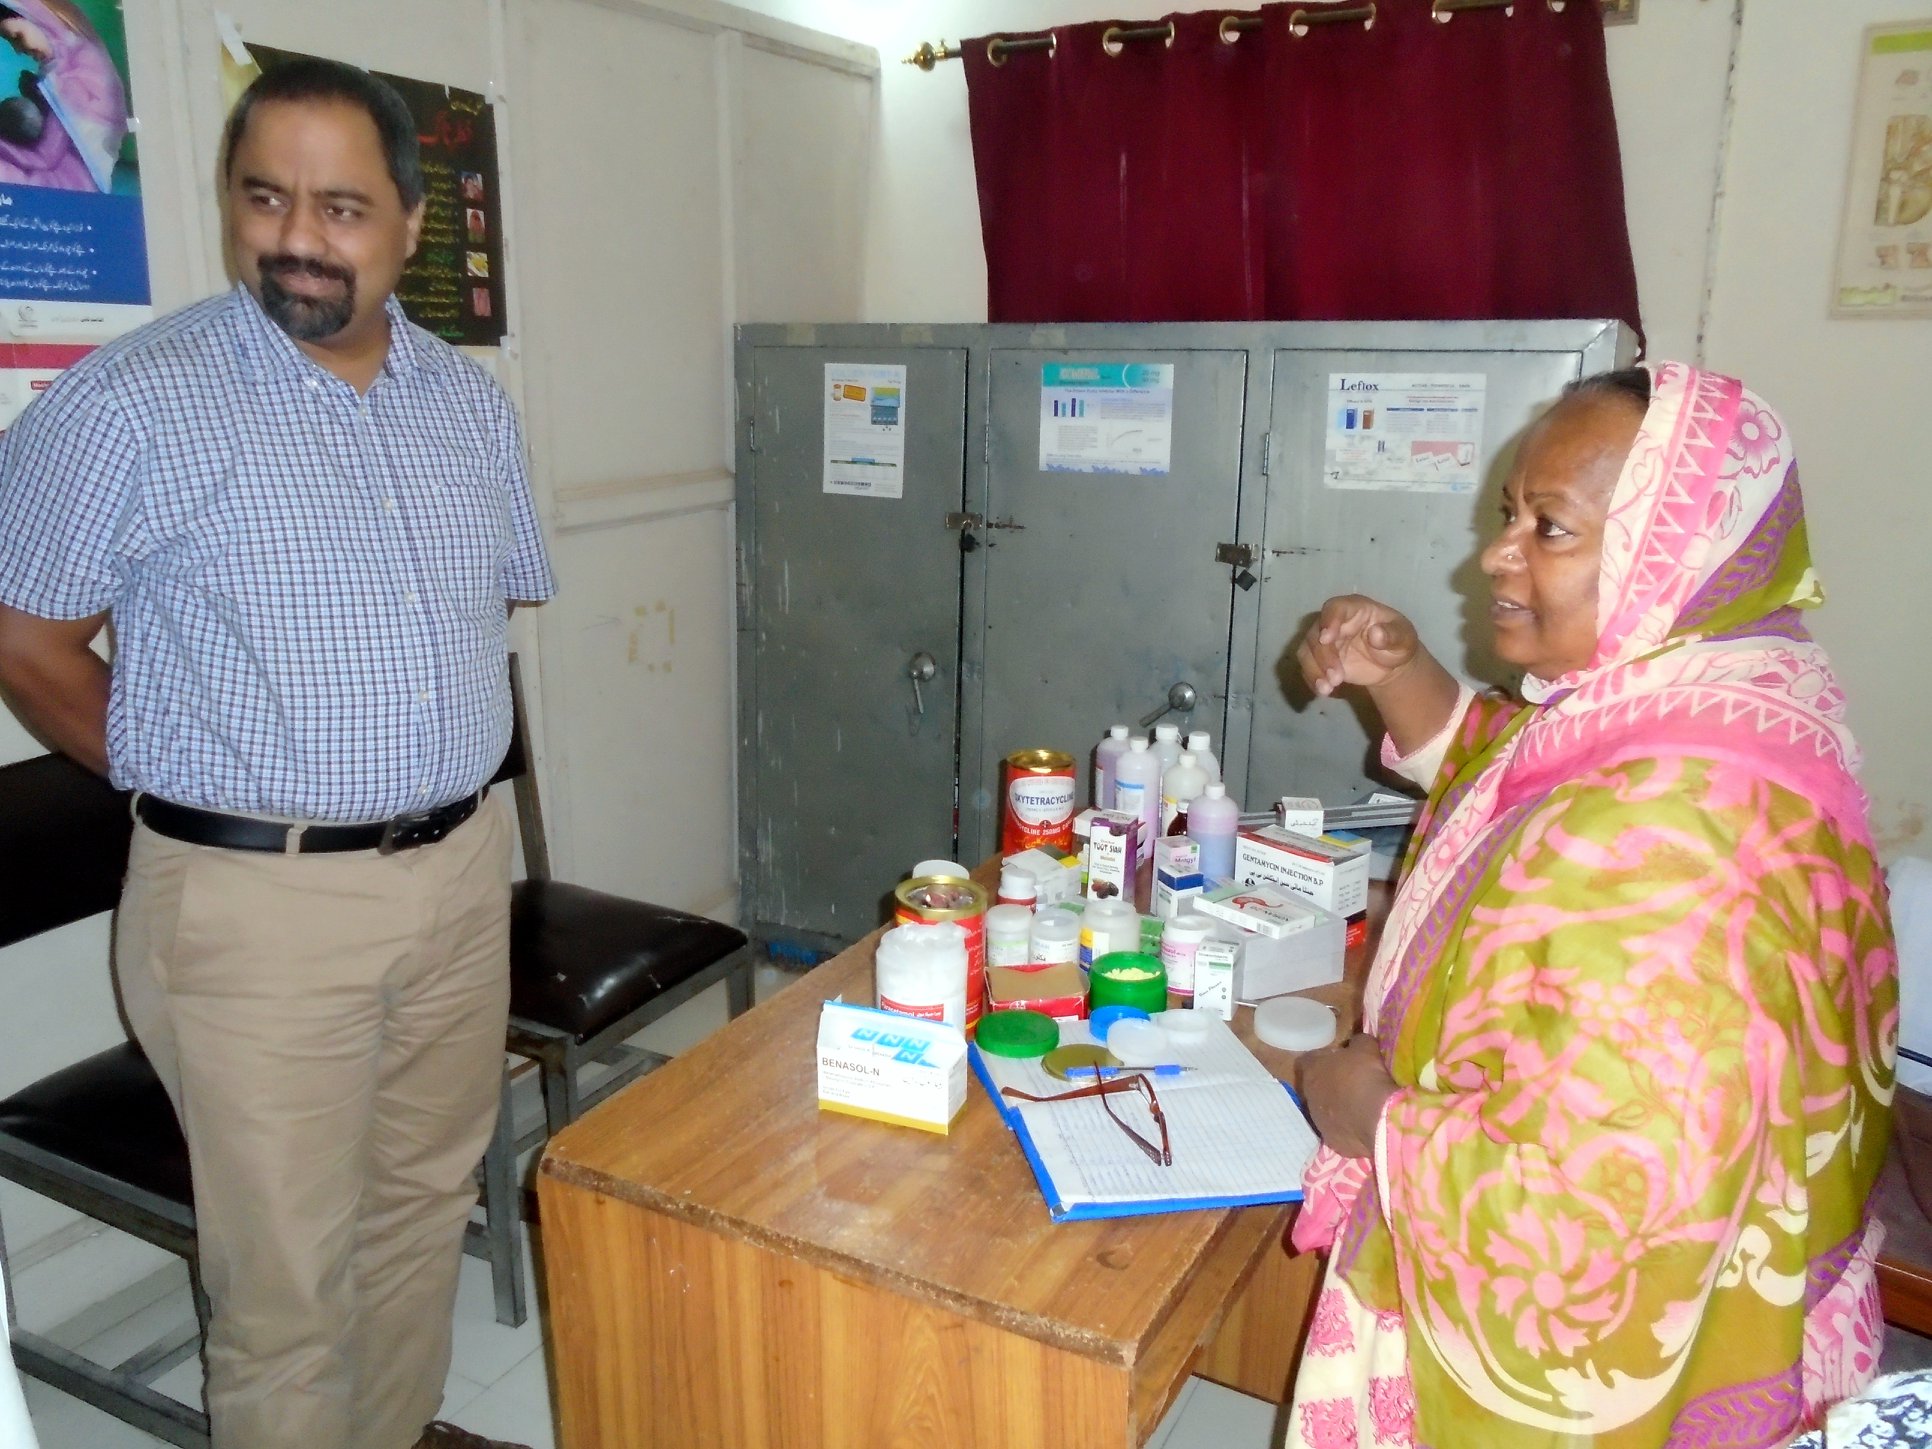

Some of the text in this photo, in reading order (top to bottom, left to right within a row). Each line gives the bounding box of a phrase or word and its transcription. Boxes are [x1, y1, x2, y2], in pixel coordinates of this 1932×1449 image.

[1093, 841, 1108, 851] TOOT
[1242, 853, 1280, 871] GENTAMYCIN
[1280, 866, 1313, 883] INJECTION
[822, 1057, 880, 1077] BENASOL-N
